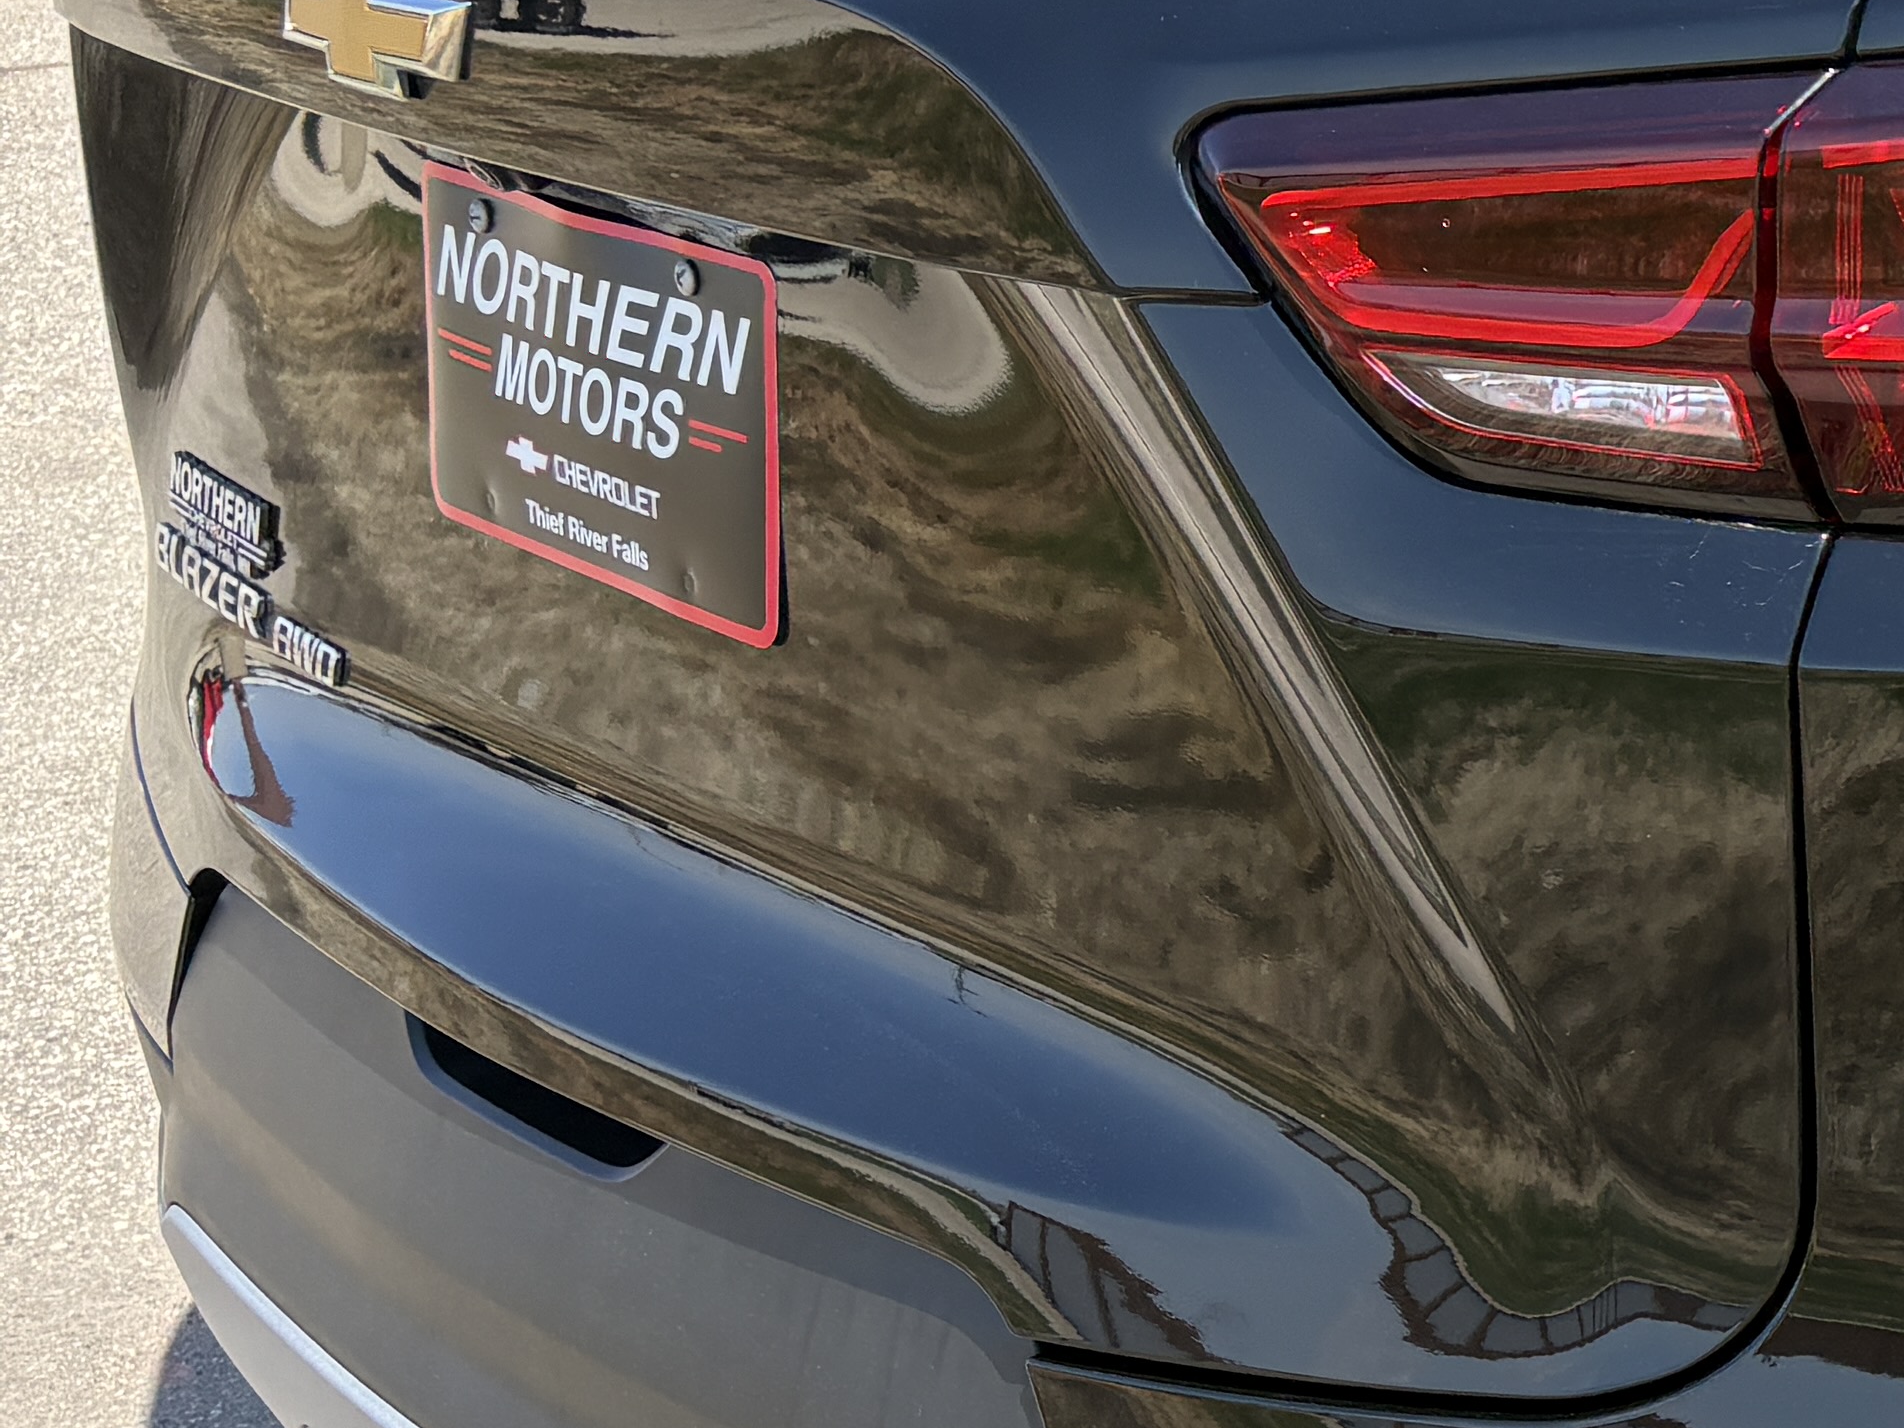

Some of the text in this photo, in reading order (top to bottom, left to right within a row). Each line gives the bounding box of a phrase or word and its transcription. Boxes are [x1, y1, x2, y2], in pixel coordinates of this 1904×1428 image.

[437, 224, 751, 395] NORTHERN
[494, 333, 684, 459] MOTORS
[170, 452, 261, 546] NORTHERN
[525, 498, 650, 572] Thief River Falls
[553, 453, 661, 520] CHEVROLET
[157, 522, 266, 639] BLAZER
[273, 615, 341, 687] AWD
